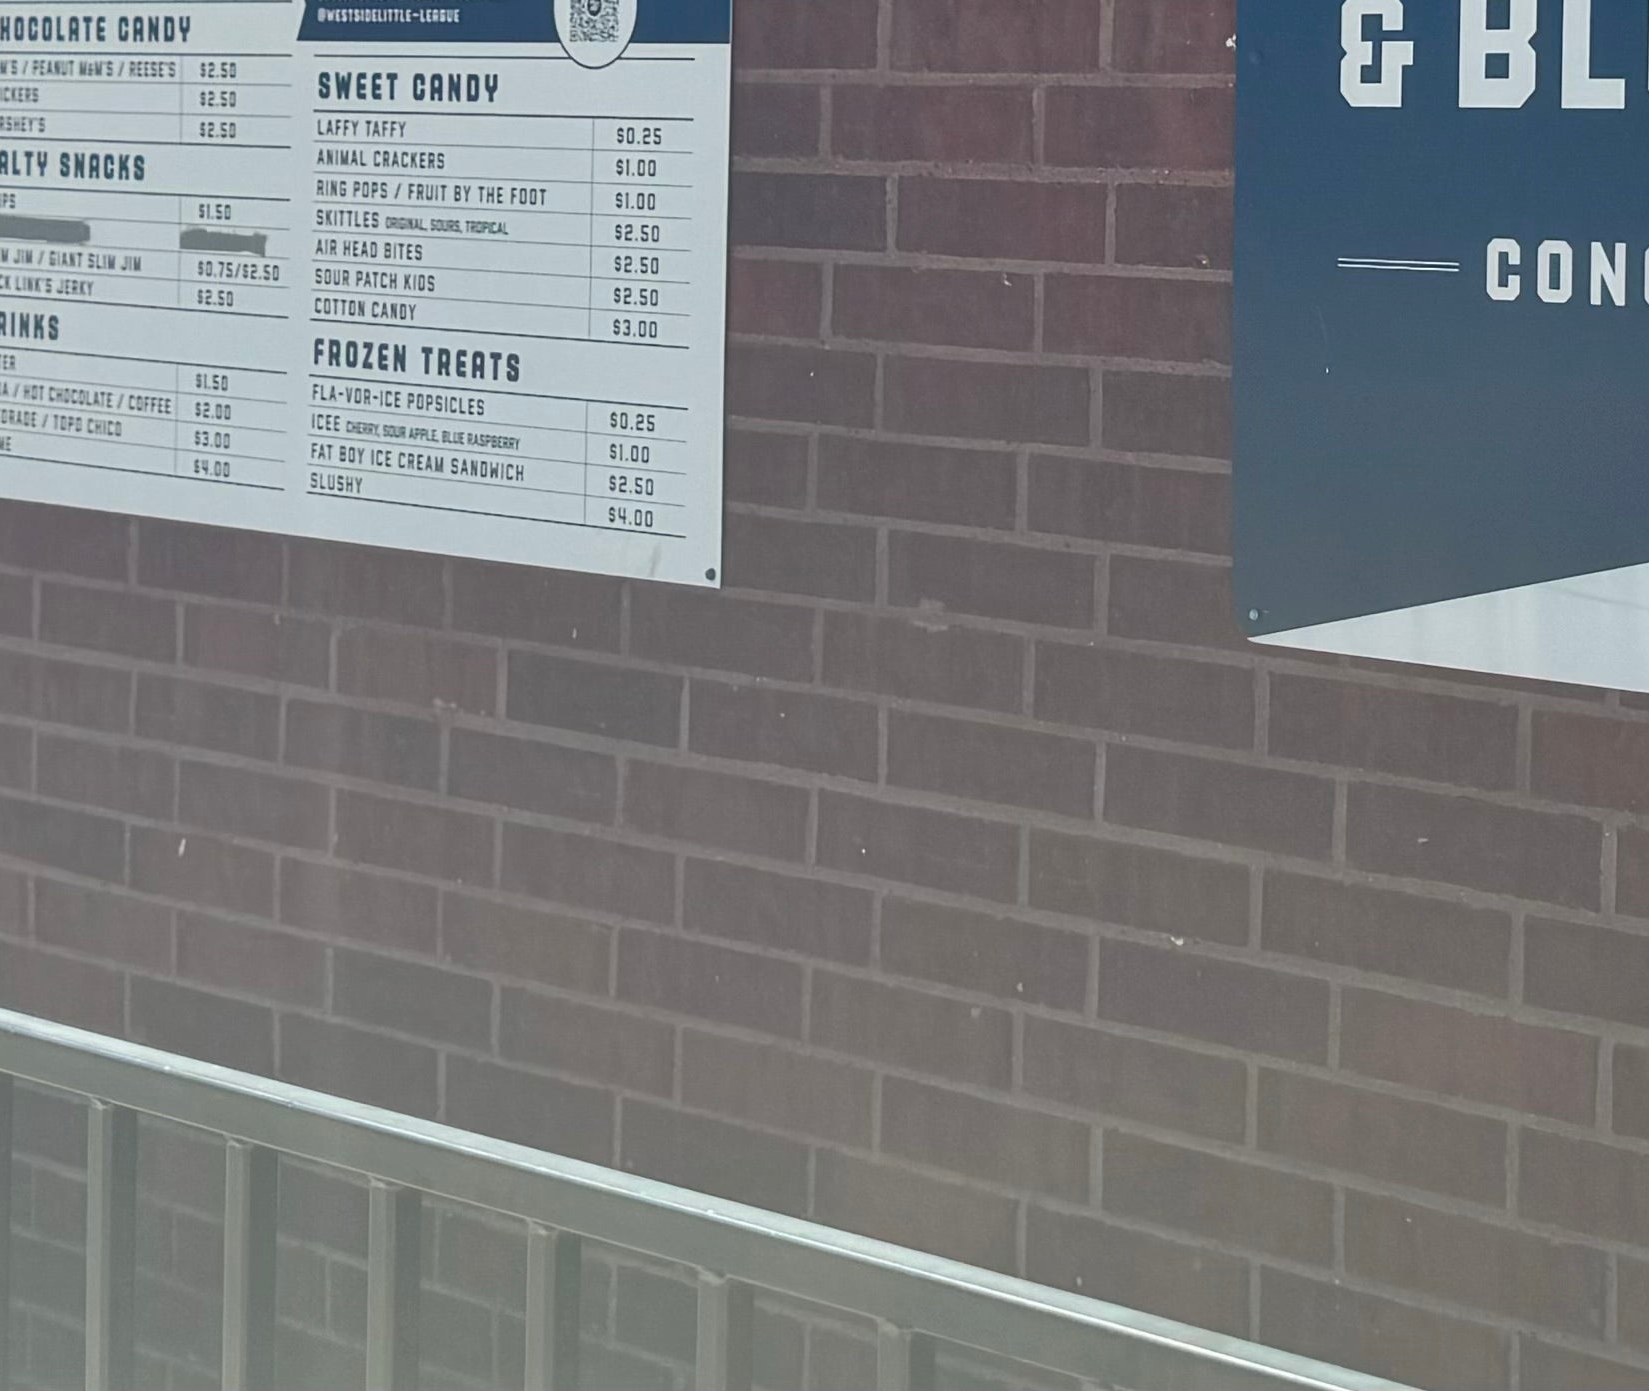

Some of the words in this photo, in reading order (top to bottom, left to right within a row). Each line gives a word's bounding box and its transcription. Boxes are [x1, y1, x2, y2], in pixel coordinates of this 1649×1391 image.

[117, 15, 192, 42] CANDY
[31, 60, 75, 77] PEANUT
[128, 61, 177, 78] REESE'S
[199, 62, 237, 80] $2.50
[199, 90, 237, 108] $2.50
[317, 71, 399, 102] SWEET
[412, 73, 500, 104] CANDY
[199, 121, 237, 139] $2.50
[317, 118, 360, 137] LAFFY
[364, 120, 407, 140] TAFFY
[615, 126, 663, 147] $0.25
[58, 151, 146, 181] SNACKS
[316, 148, 368, 168] ANIMAL
[372, 149, 446, 170] CRACKERS
[615, 158, 657, 178] $1.00
[316, 179, 348, 198] RING
[352, 180, 389, 200] POPS
[407, 182, 447, 203] FRUIT
[453, 184, 472, 204] BY
[477, 185, 505, 205] THE
[509, 186, 548, 207] FOOT
[615, 191, 656, 211] $1.00
[198, 203, 232, 221] $1.50
[315, 208, 380, 229] SKITTLES
[464, 219, 509, 237] TROPICAL
[614, 223, 661, 244] $2.50
[12, 247, 34, 265] JIM
[48, 249, 84, 269] GIANT
[87, 251, 114, 271] SLIM
[119, 255, 142, 273] JIM
[314, 238, 339, 257] AIR
[342, 240, 379, 260] HEAD
[383, 242, 424, 262] BITES
[613, 255, 660, 276] $2.50
[14, 275, 53, 294] LINK'S
[56, 278, 94, 297] JERKY
[197, 289, 234, 308] $2.50
[314, 268, 350, 287] SOUR
[354, 269, 399, 290] PATCH
[403, 272, 436, 293] KIDS
[613, 287, 659, 308] $2.50
[314, 297, 367, 318] COTTON
[371, 299, 417, 322] CANDY
[612, 318, 659, 339] $3.00
[313, 337, 407, 374] FROZEN
[420, 344, 521, 383] TREATS
[195, 373, 229, 392] $1.50
[22, 383, 45, 401] HOT
[48, 385, 114, 409] CHOCOLATE
[128, 392, 172, 416] COFFEE
[194, 401, 232, 421] $2.00
[312, 382, 402, 409] FLA-VOR-ICE
[406, 394, 485, 417] POPSICLES
[609, 410, 656, 433] $0.25
[52, 413, 84, 432] TOPO
[86, 416, 123, 437] CHICO
[193, 430, 231, 450] $3.00
[311, 413, 341, 433] ICEE
[382, 424, 407, 440] SOUR
[441, 428, 465, 446] BLUE
[466, 431, 521, 451] RASPBERRY
[609, 442, 651, 464] $1.00
[193, 458, 231, 478] $4.00
[310, 442, 334, 462] FAT
[339, 445, 366, 465] BOY
[370, 448, 393, 468] ICE
[397, 451, 445, 474] CREAM
[450, 457, 525, 482] SANDWICH
[608, 474, 655, 497] $2.50
[309, 471, 364, 495] SLUSHY
[607, 506, 654, 528] $4.00
